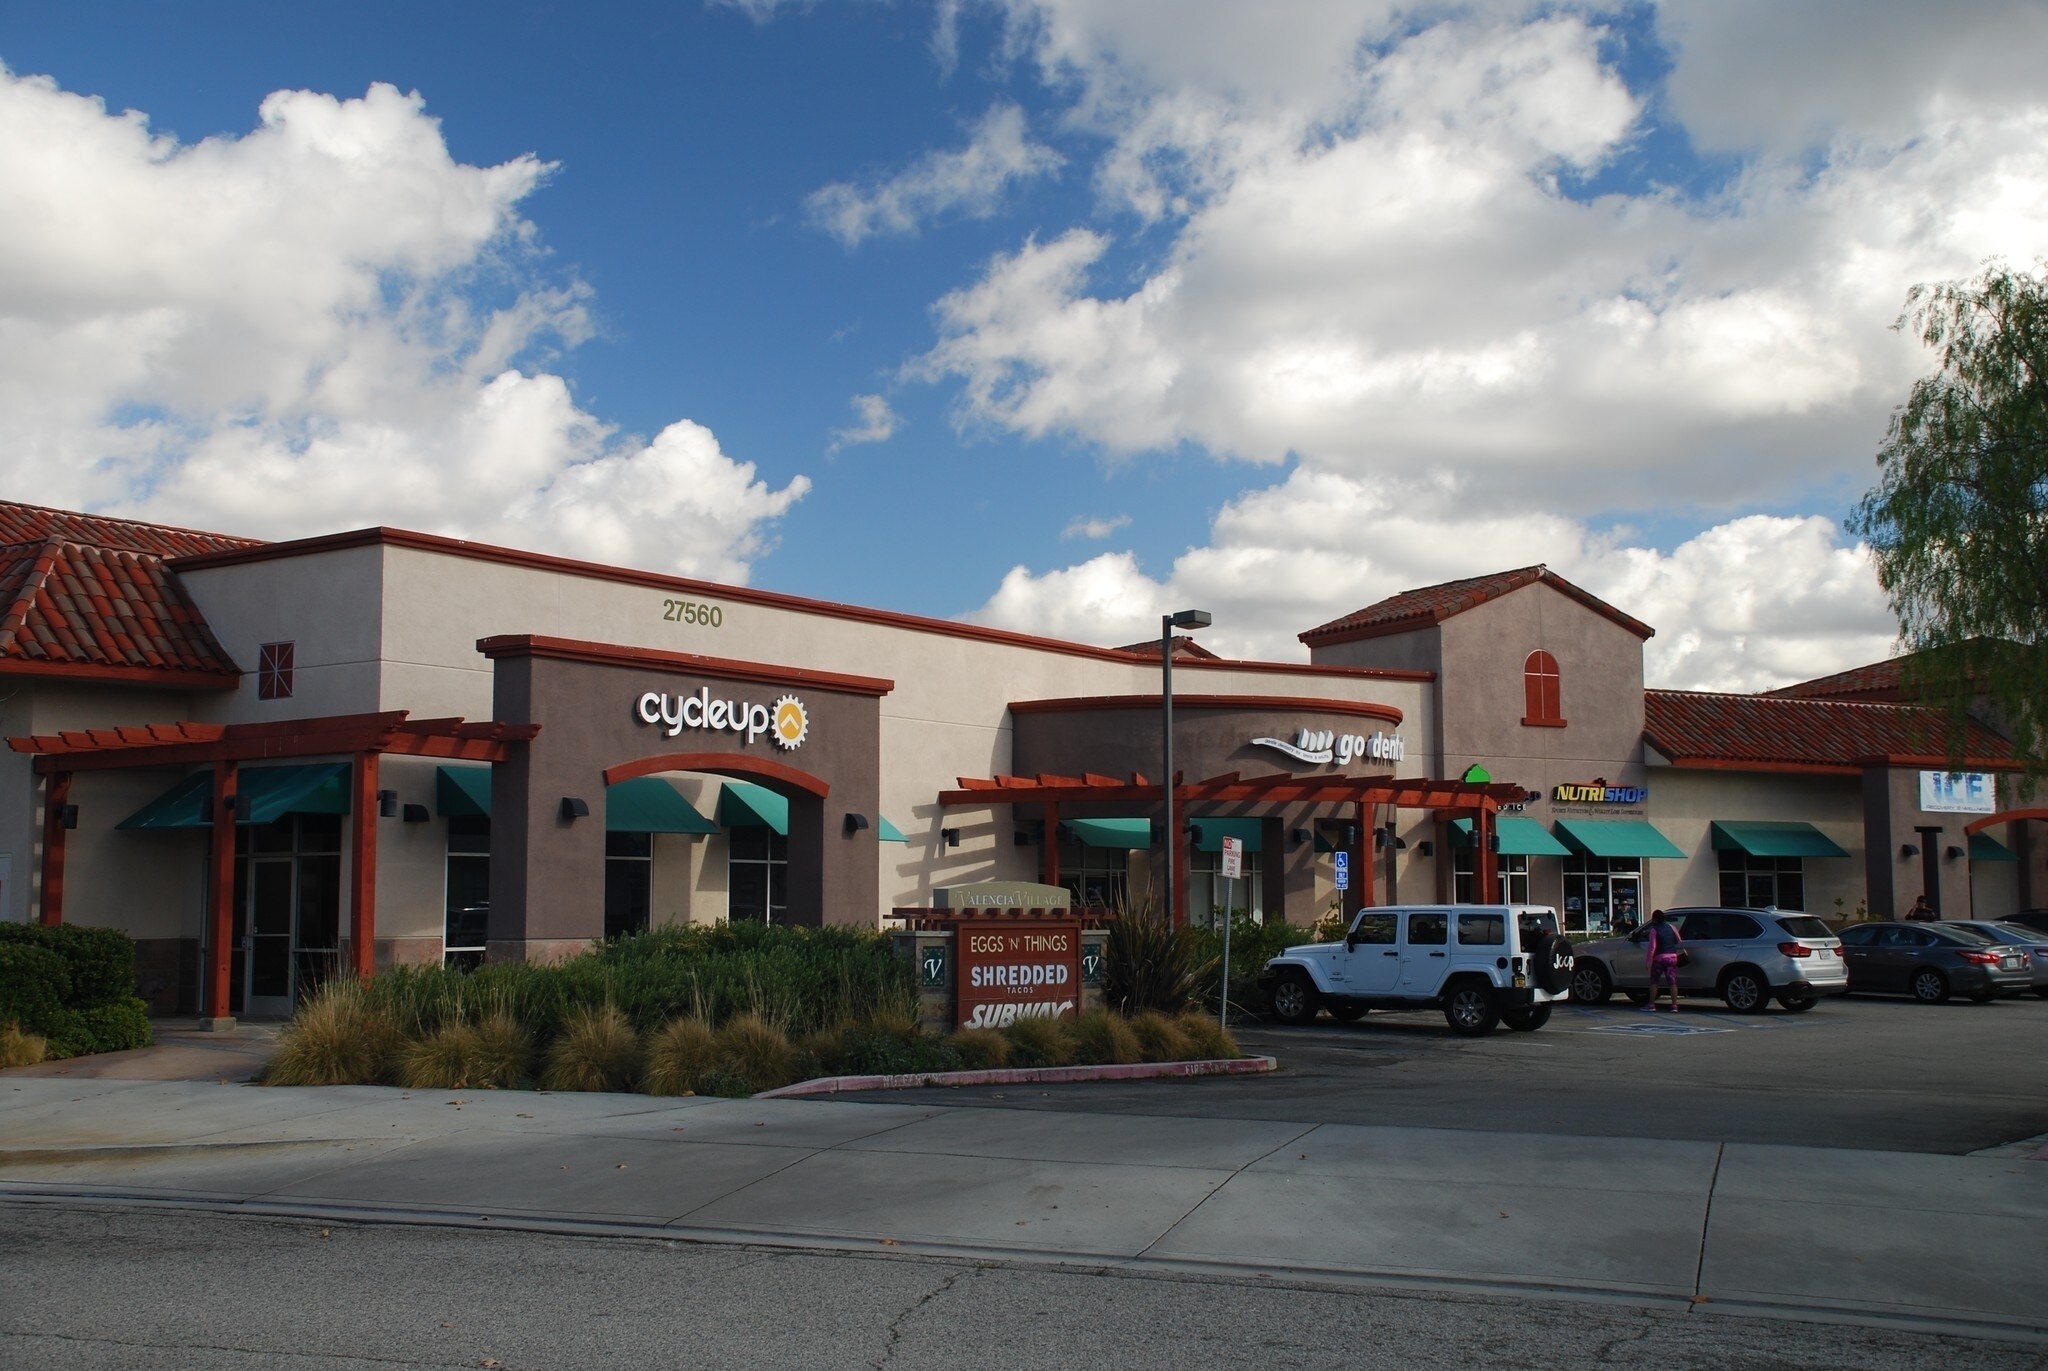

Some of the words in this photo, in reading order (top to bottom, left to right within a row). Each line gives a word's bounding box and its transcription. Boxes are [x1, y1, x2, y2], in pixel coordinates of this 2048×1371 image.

[663, 599, 723, 628] 27560
[639, 686, 769, 743] cycleup
[1334, 734, 1365, 765] go
[1556, 786, 1648, 802] NUTRISHOP
[1224, 839, 1232, 848] NO
[1224, 849, 1240, 858] PARKING
[955, 891, 1014, 906] VALENCIA
[1015, 891, 1063, 906] VILLAGE
[970, 936, 1004, 953] EGGS
[1024, 935, 1068, 952] THINGS
[971, 964, 1068, 987] SHREDDED
[1006, 986, 1034, 994] TACOS
[963, 1000, 1073, 1030] SUBWAY
